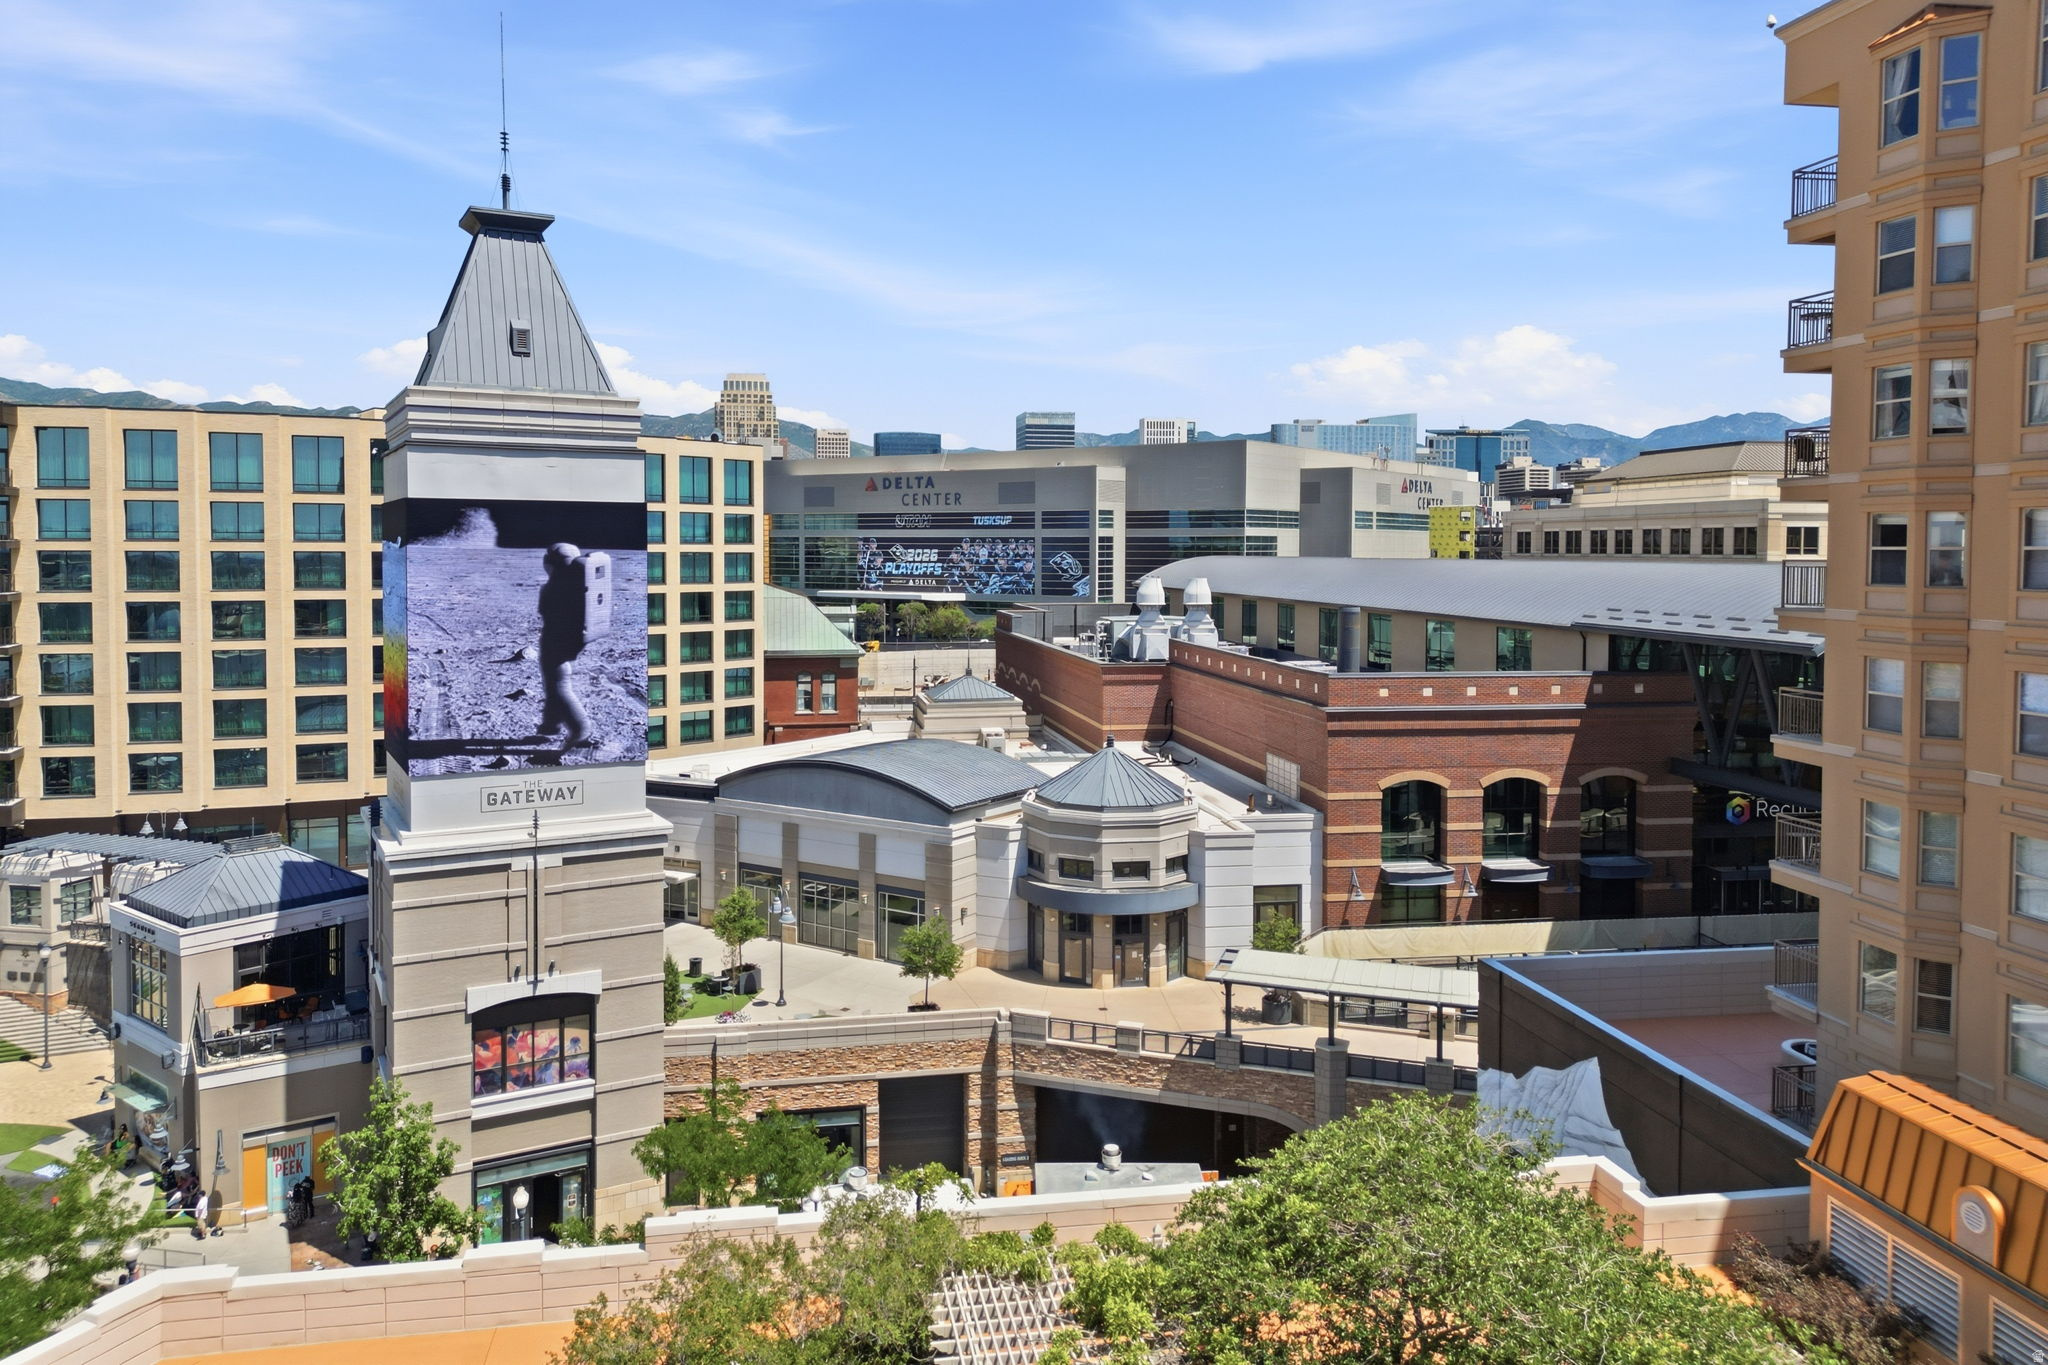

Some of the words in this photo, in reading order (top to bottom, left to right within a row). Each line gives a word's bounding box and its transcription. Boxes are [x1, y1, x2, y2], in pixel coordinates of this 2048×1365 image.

[882, 476, 935, 490] DELTA
[1408, 479, 1433, 494] DELTA
[901, 493, 962, 506] CENTER
[906, 548, 939, 561] 2026
[884, 562, 943, 575] PLAYOFFS
[522, 779, 543, 789] THE
[486, 786, 577, 806] GATEWAY
[272, 1141, 306, 1162] DON'T
[275, 1158, 304, 1178] PEEK
